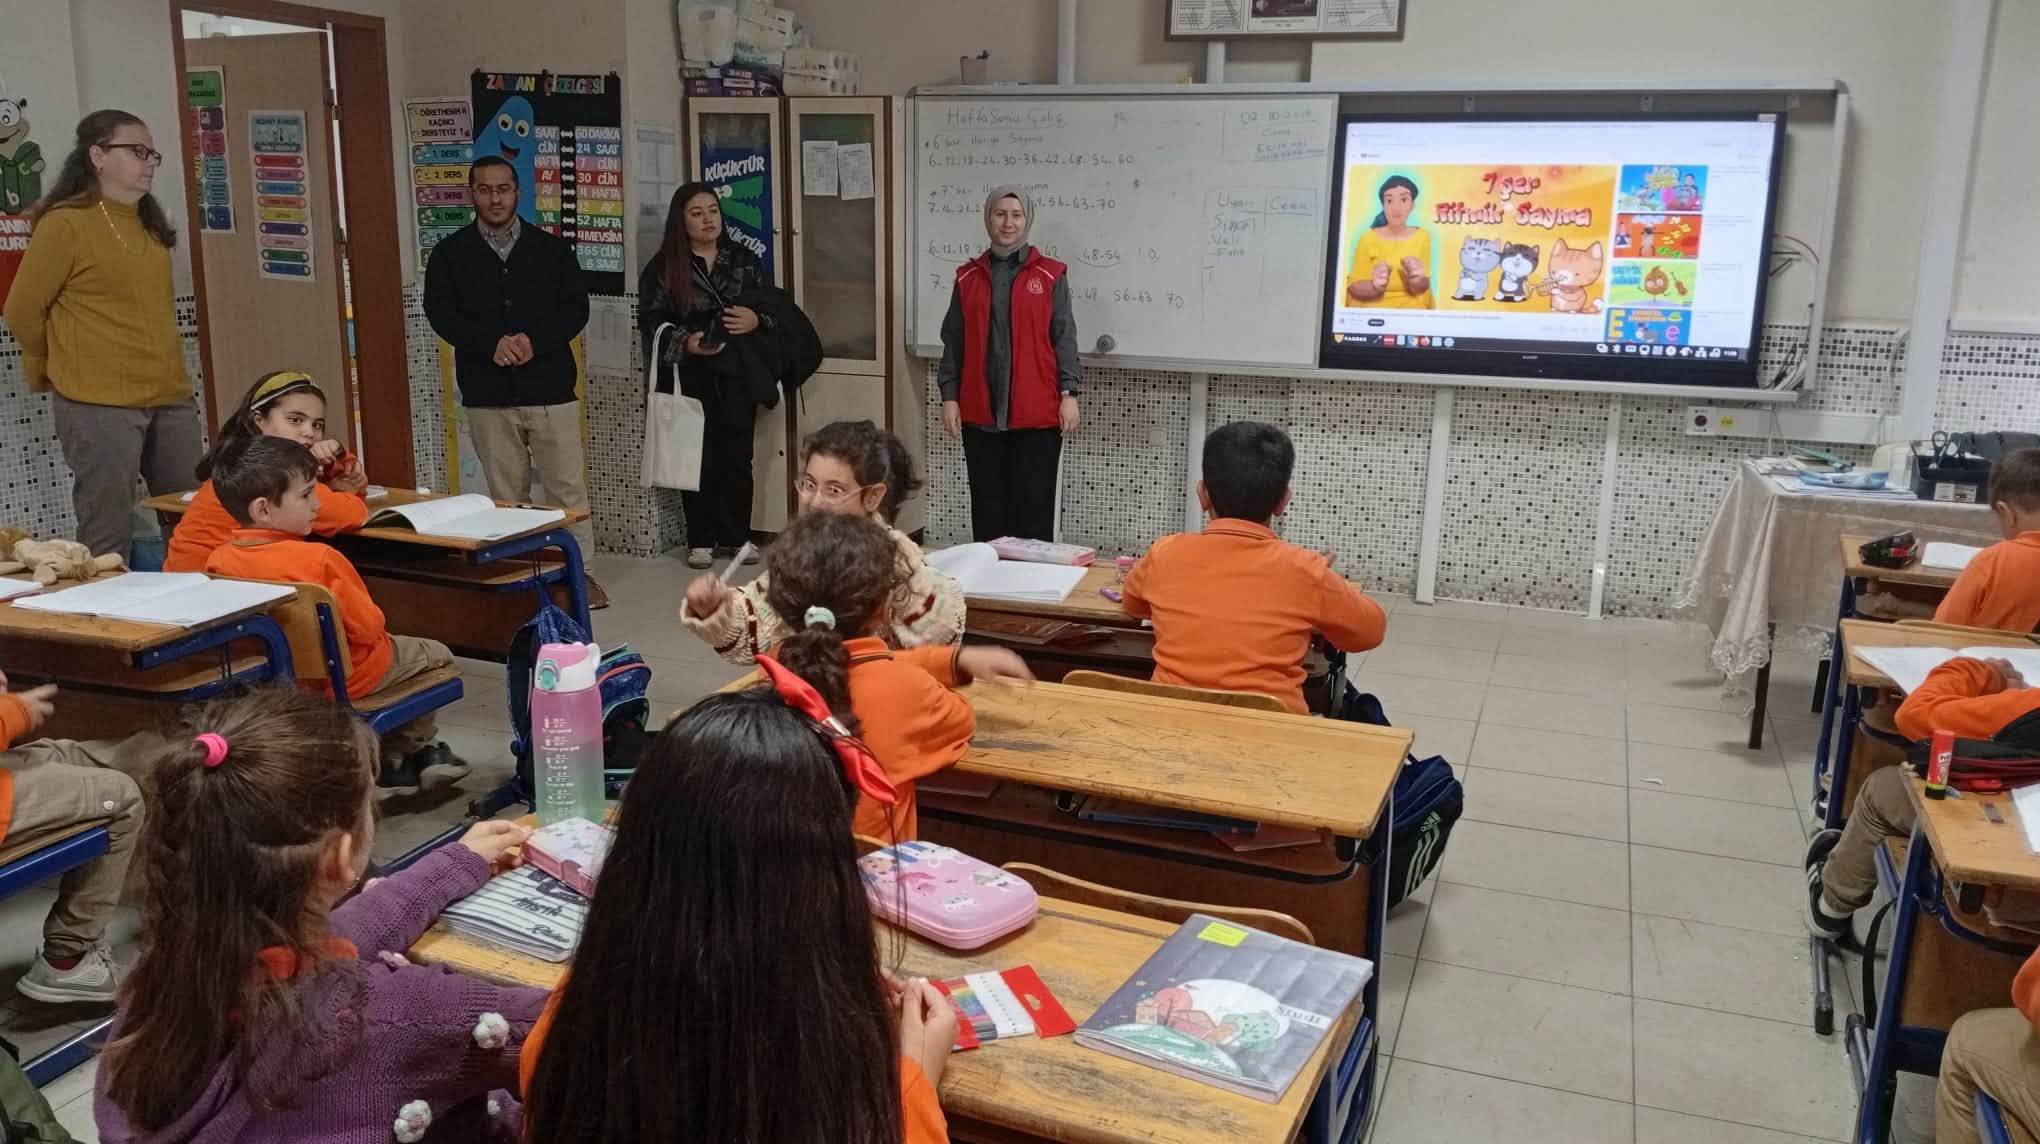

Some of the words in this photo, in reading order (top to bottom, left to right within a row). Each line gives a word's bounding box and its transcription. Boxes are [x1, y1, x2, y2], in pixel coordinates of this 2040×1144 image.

[539, 142, 557, 153] GÜN
[577, 143, 590, 153] 24
[596, 144, 619, 154] SAAT
[598, 156, 617, 169] GÜN
[705, 154, 765, 182] KÜÇÜKTÜR
[578, 172, 591, 183] 30
[598, 172, 617, 185] GÜN
[592, 188, 620, 199] HAFTA
[542, 211, 556, 223] YIL
[577, 215, 590, 225] 52
[593, 217, 621, 229] HAFTA
[585, 230, 622, 242] MEVSİM
[726, 225, 767, 259] ÜKTÜR
[577, 246, 598, 256] 365
[600, 246, 620, 258] GÜN
[597, 259, 619, 270] SAAT
